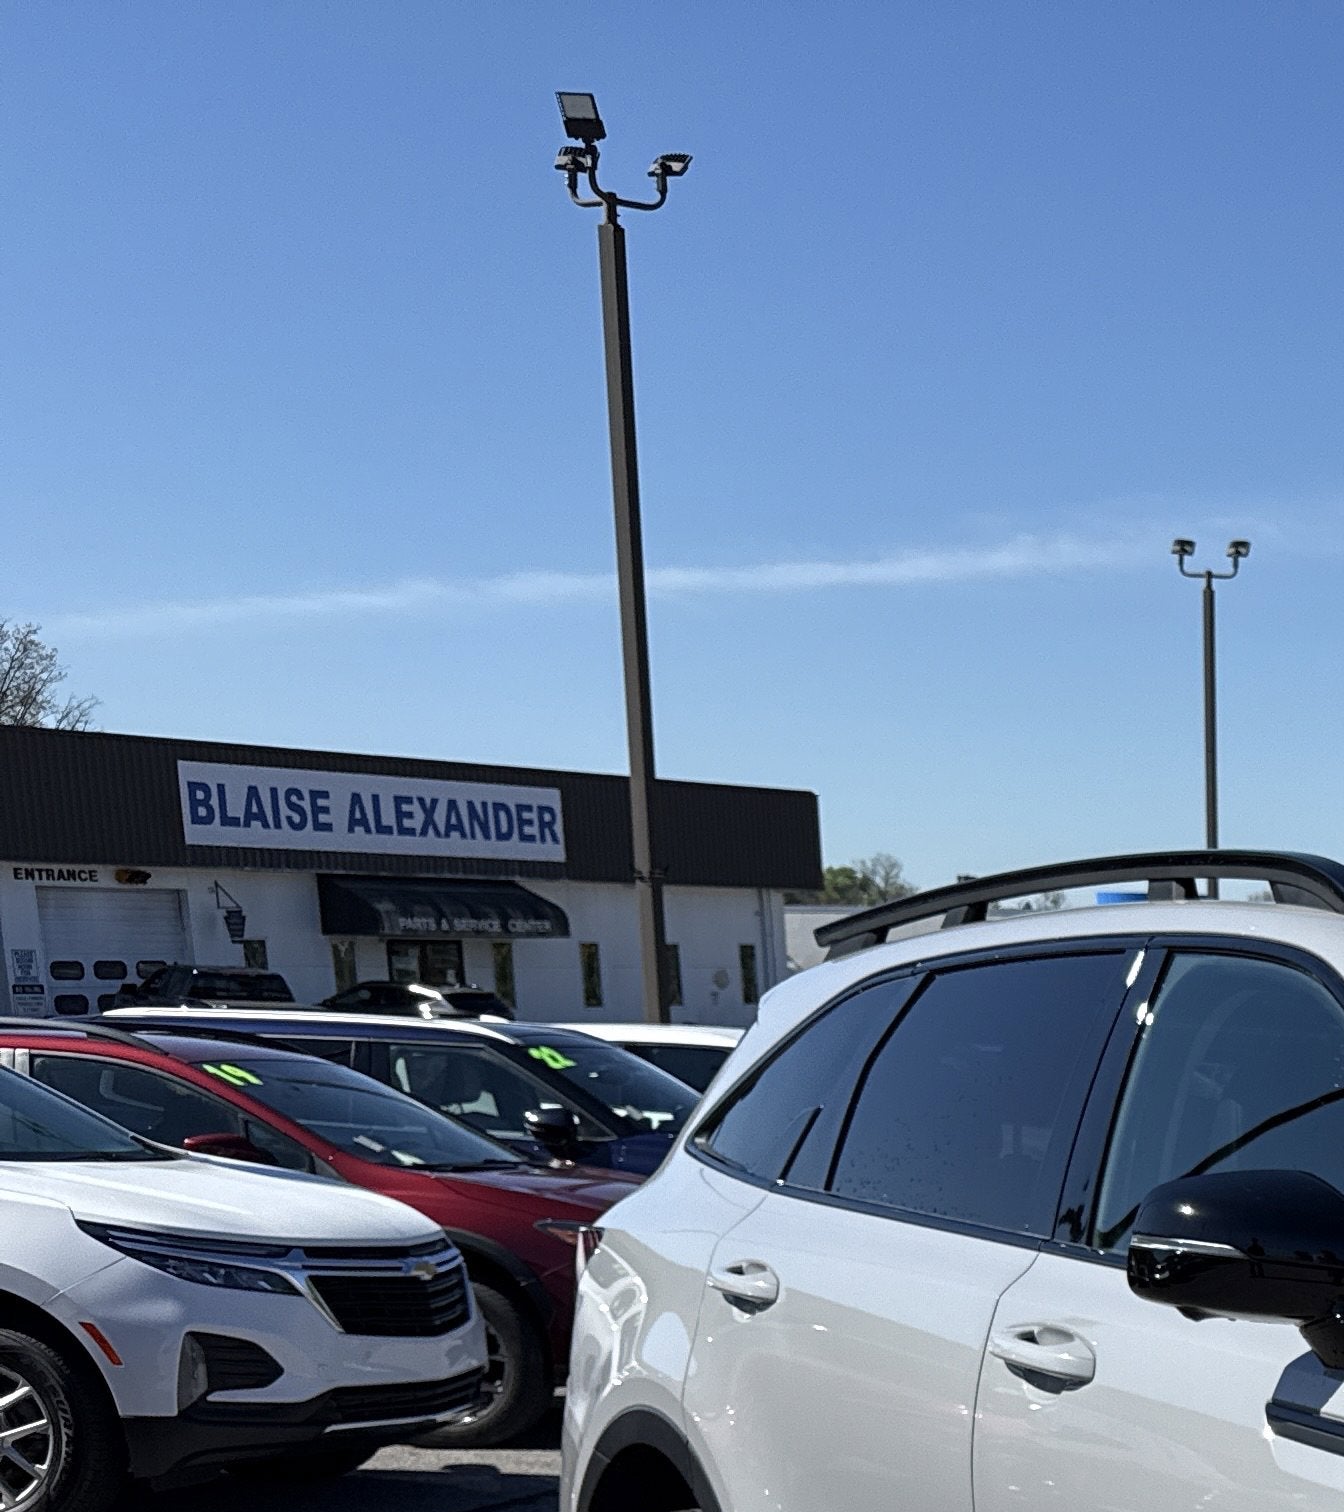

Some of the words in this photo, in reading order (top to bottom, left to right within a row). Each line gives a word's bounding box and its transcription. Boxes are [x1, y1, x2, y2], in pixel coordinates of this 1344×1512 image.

[185, 780, 334, 833] BLAISE
[346, 791, 561, 846] ALEXANDER
[12, 867, 99, 883] ENTRANCE
